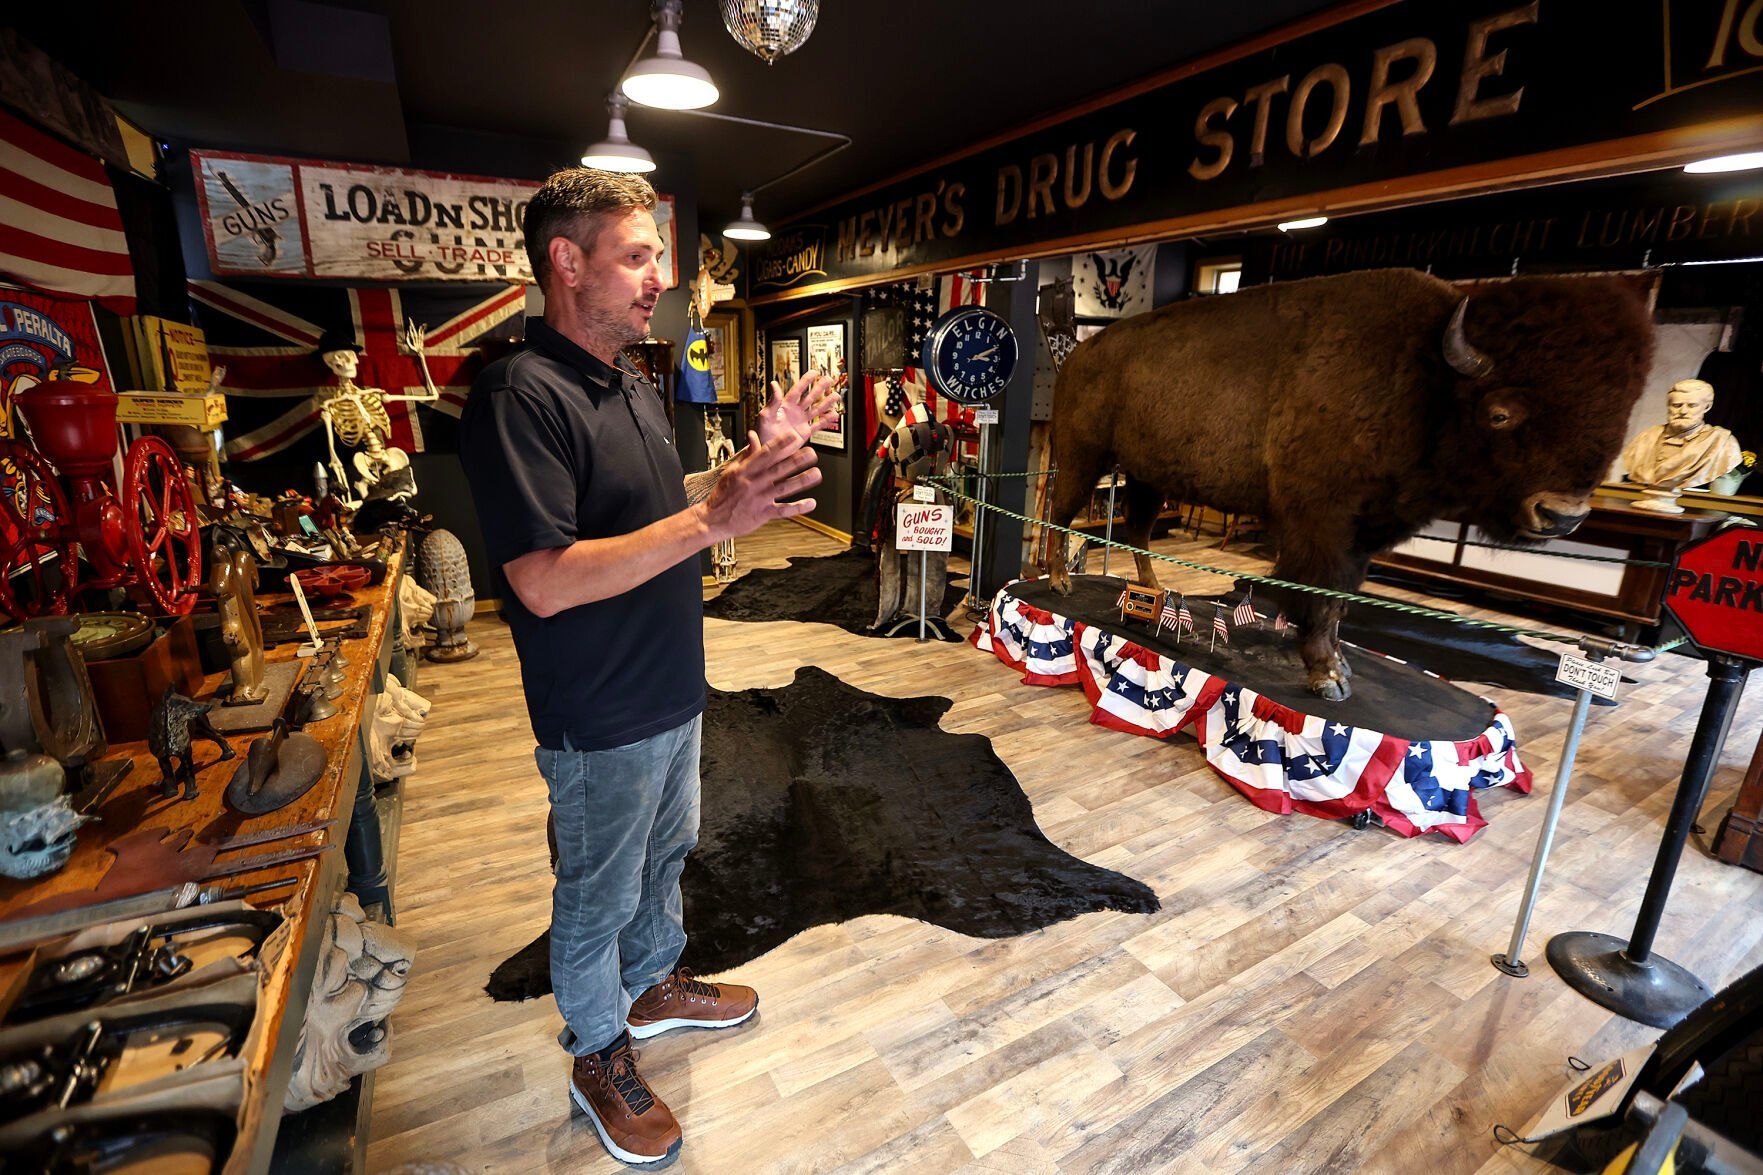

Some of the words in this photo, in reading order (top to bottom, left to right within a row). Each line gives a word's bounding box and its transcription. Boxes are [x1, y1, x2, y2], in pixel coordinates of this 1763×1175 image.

[835, 178, 968, 263] MEYER'S
[994, 128, 1139, 227] DRUG
[1187, 0, 1539, 182] STORE
[319, 183, 432, 226] LOAD
[222, 197, 290, 236] GUNS
[1574, 198, 1761, 249] LUMBER
[366, 241, 426, 261] SELL
[437, 246, 515, 264] TRADE
[13, 308, 72, 358] PERALTA
[865, 310, 904, 365] TAILOR
[951, 316, 1008, 340] ELGIN
[965, 334, 970, 342] 11
[975, 331, 981, 339] 12
[952, 351, 958, 359] 9
[956, 341, 963, 349] 10
[960, 371, 966, 379] 7
[970, 374, 976, 382] 6
[980, 372, 986, 380] 5
[946, 376, 1005, 399] WATCHES
[903, 508, 943, 529] GUNS
[913, 526, 946, 535] BOUGHT
[916, 535, 948, 547] SOLD!
[1732, 540, 1763, 572] N
[1563, 663, 1586, 678] DON'T
[1587, 671, 1614, 688] TOUCH
[1568, 675, 1586, 685] Thank
